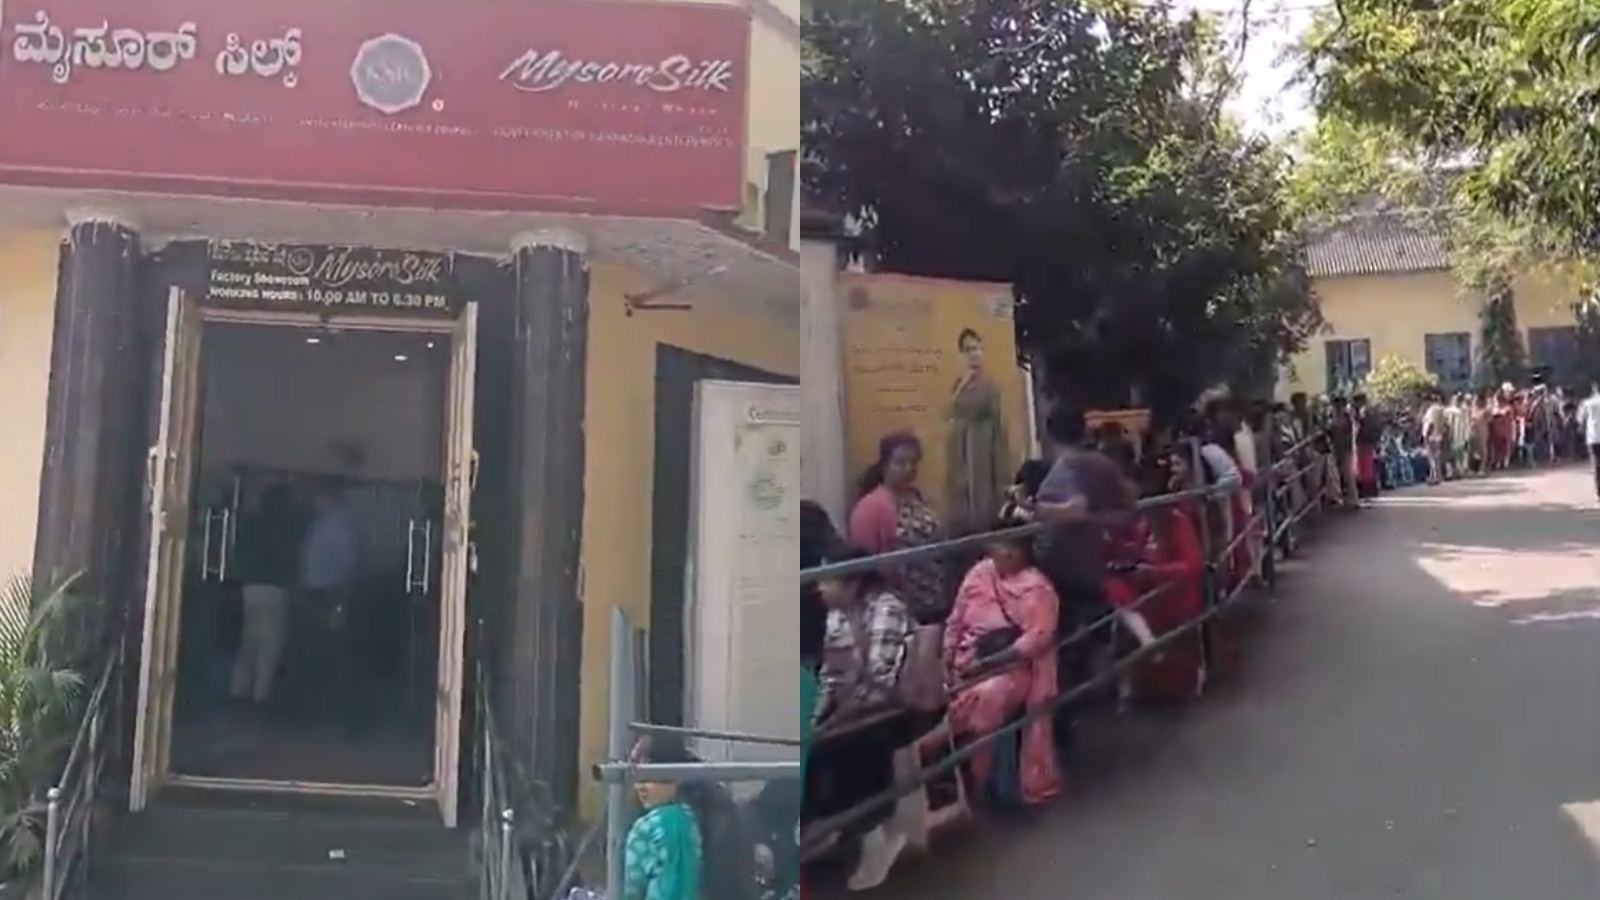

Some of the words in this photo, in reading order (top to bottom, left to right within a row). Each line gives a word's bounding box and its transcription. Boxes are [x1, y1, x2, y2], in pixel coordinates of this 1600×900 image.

[211, 269, 252, 286] Factory
[253, 272, 310, 286] Showroom
[208, 286, 260, 299] WORKING
[306, 288, 343, 303] 10.00
[345, 290, 368, 305] AM
[371, 291, 390, 306] TO
[424, 294, 447, 308] PM
